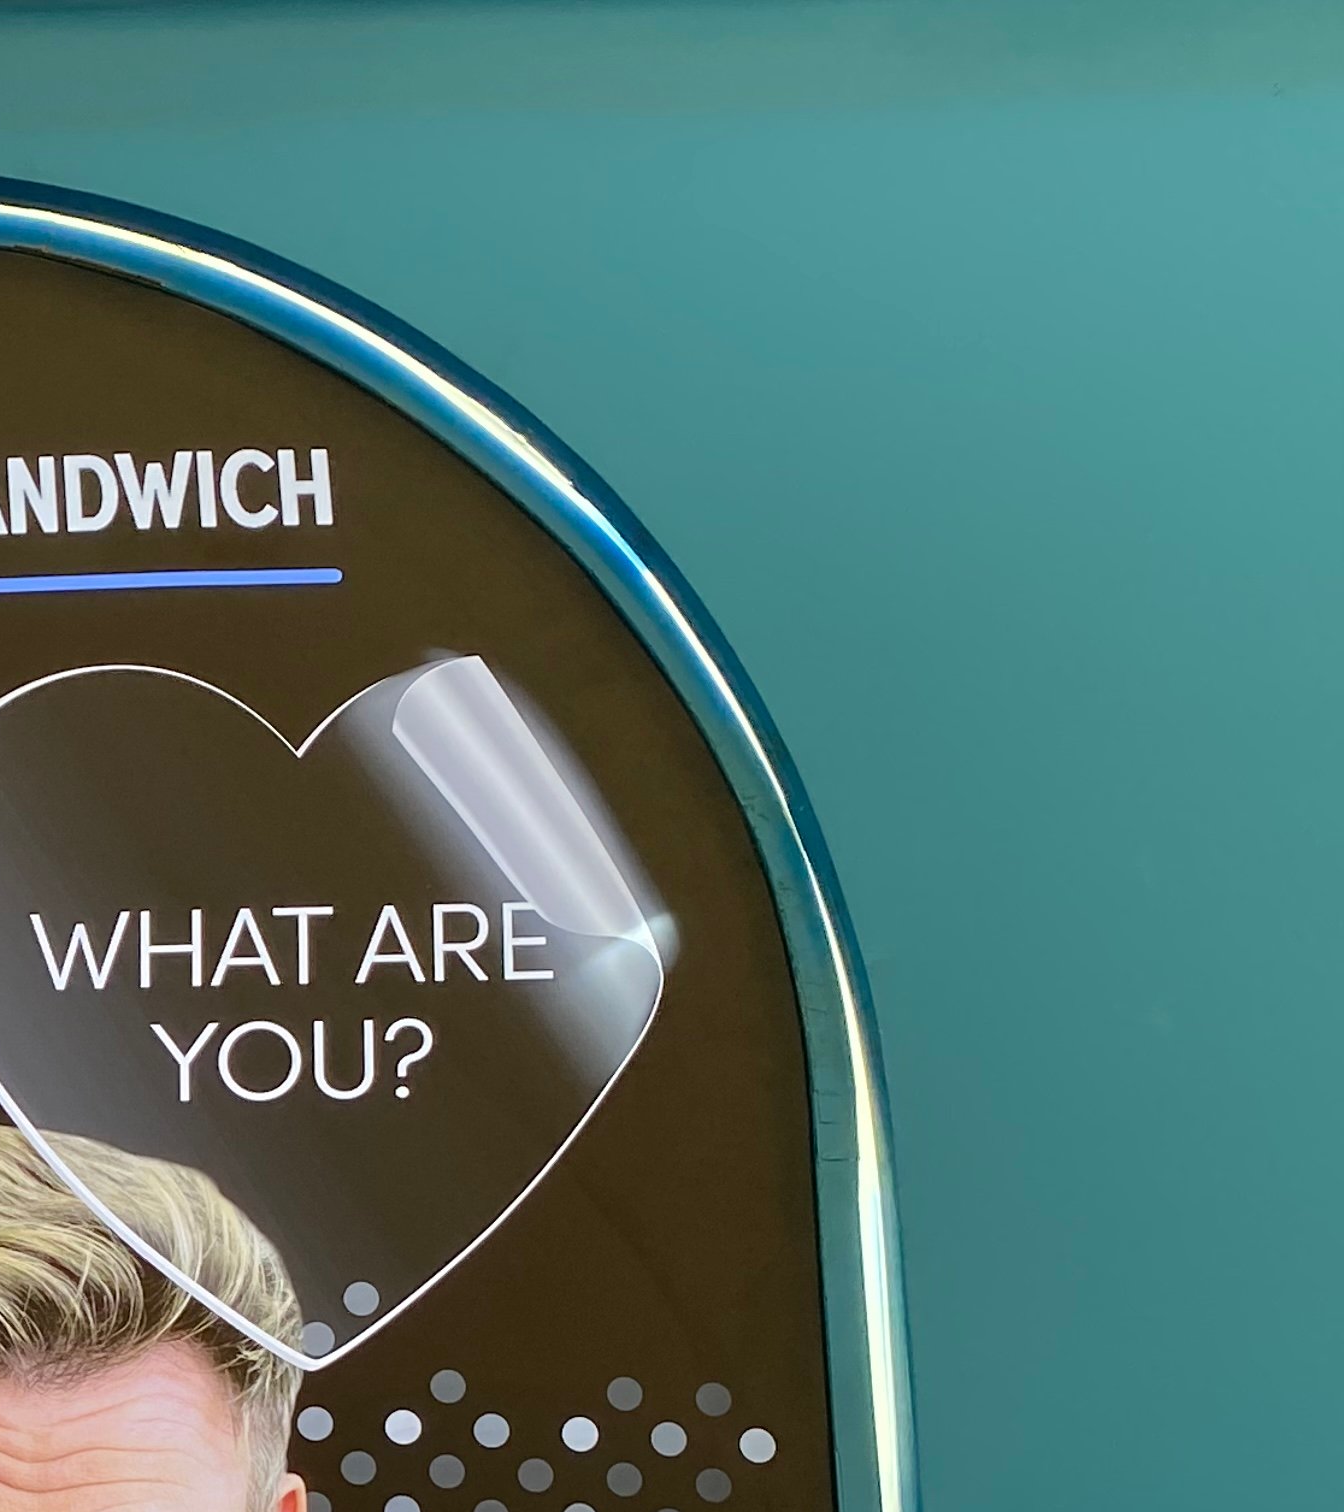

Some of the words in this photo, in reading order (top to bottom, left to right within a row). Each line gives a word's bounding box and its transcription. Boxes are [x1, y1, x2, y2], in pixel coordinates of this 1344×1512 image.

[28, 904, 335, 992] WHAT
[354, 901, 555, 984] ARE
[149, 1016, 435, 1102] YOU?
